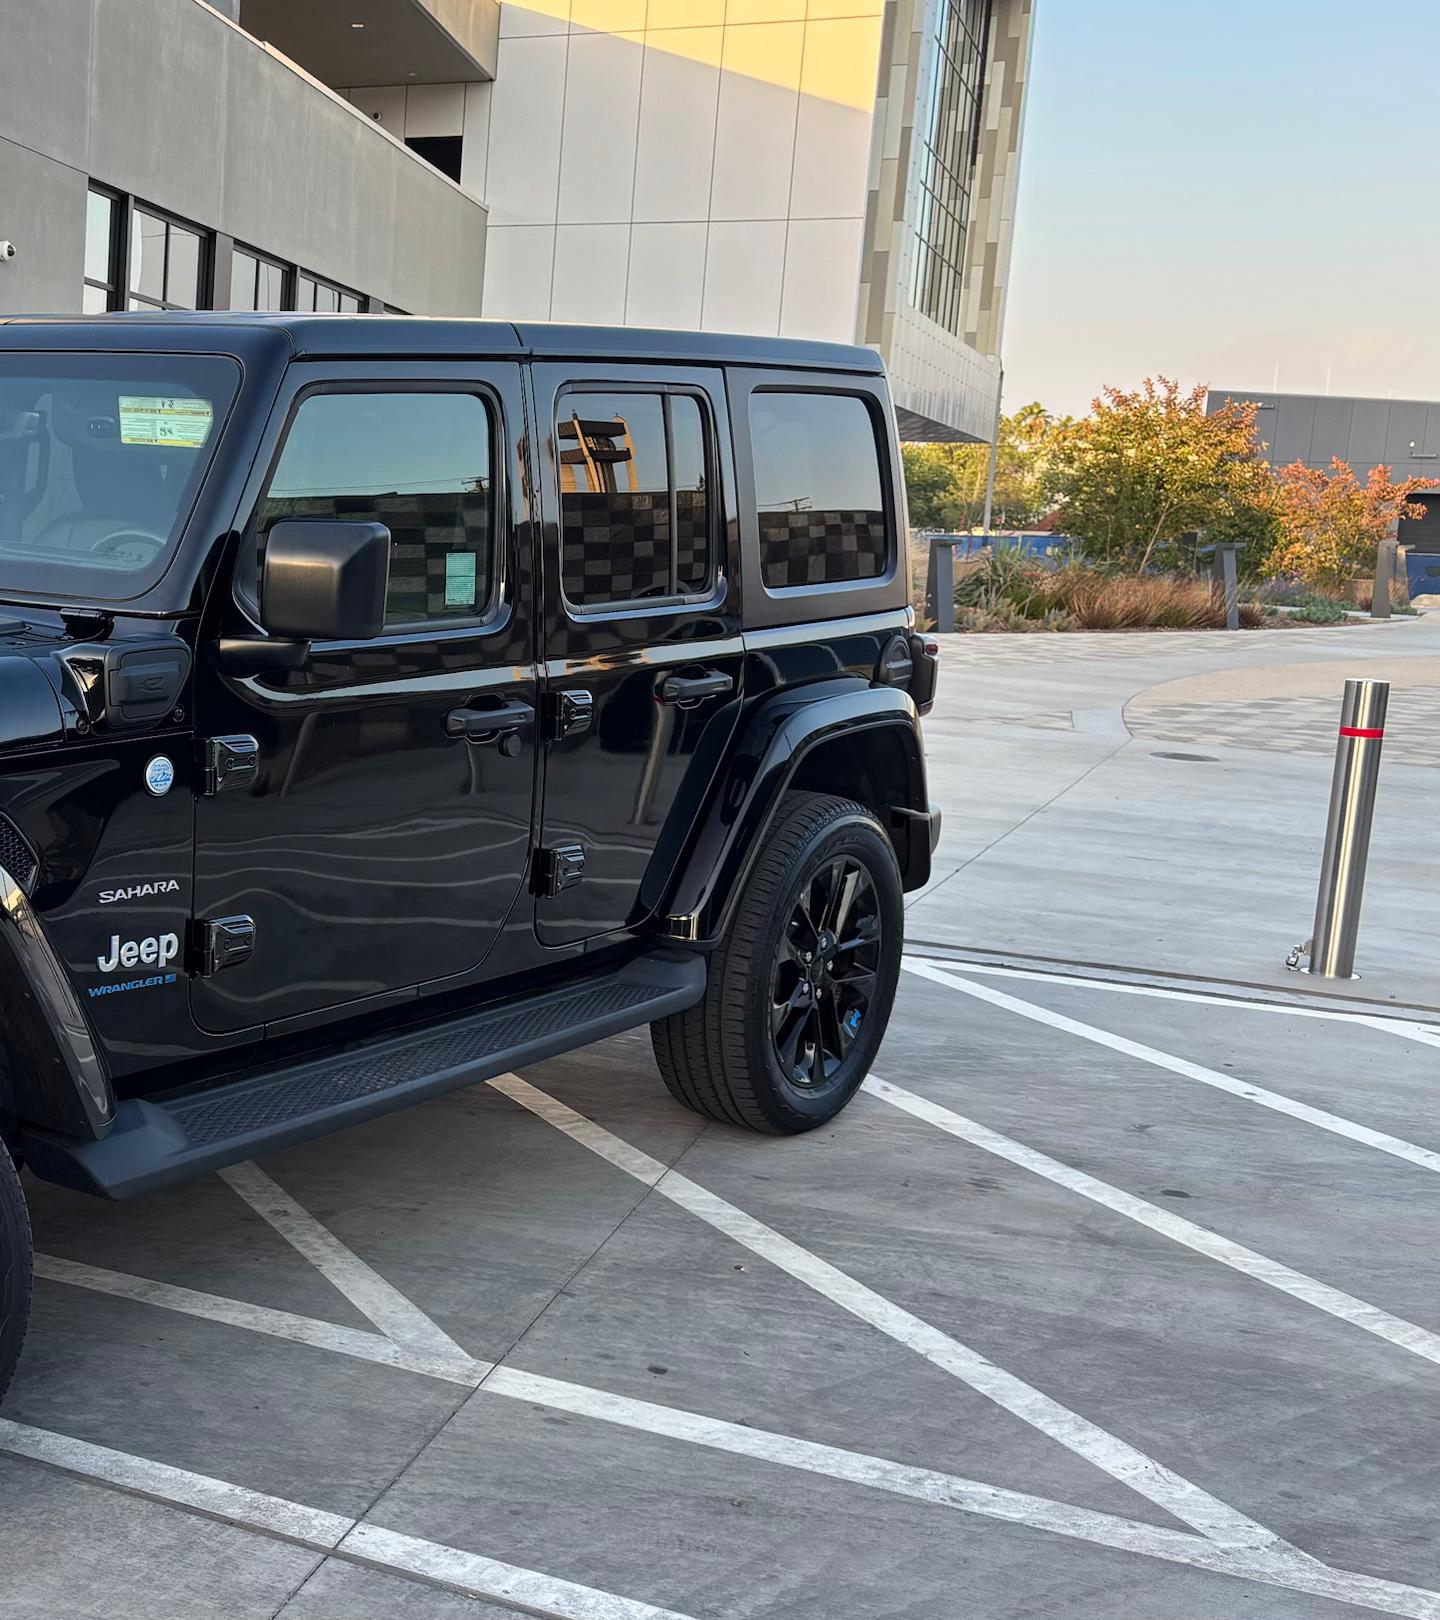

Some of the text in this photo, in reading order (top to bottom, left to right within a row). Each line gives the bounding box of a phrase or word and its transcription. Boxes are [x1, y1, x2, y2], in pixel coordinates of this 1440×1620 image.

[98, 879, 180, 904] SAHARA
[96, 932, 179, 973] Jeep
[87, 975, 164, 998] WRANGLER
